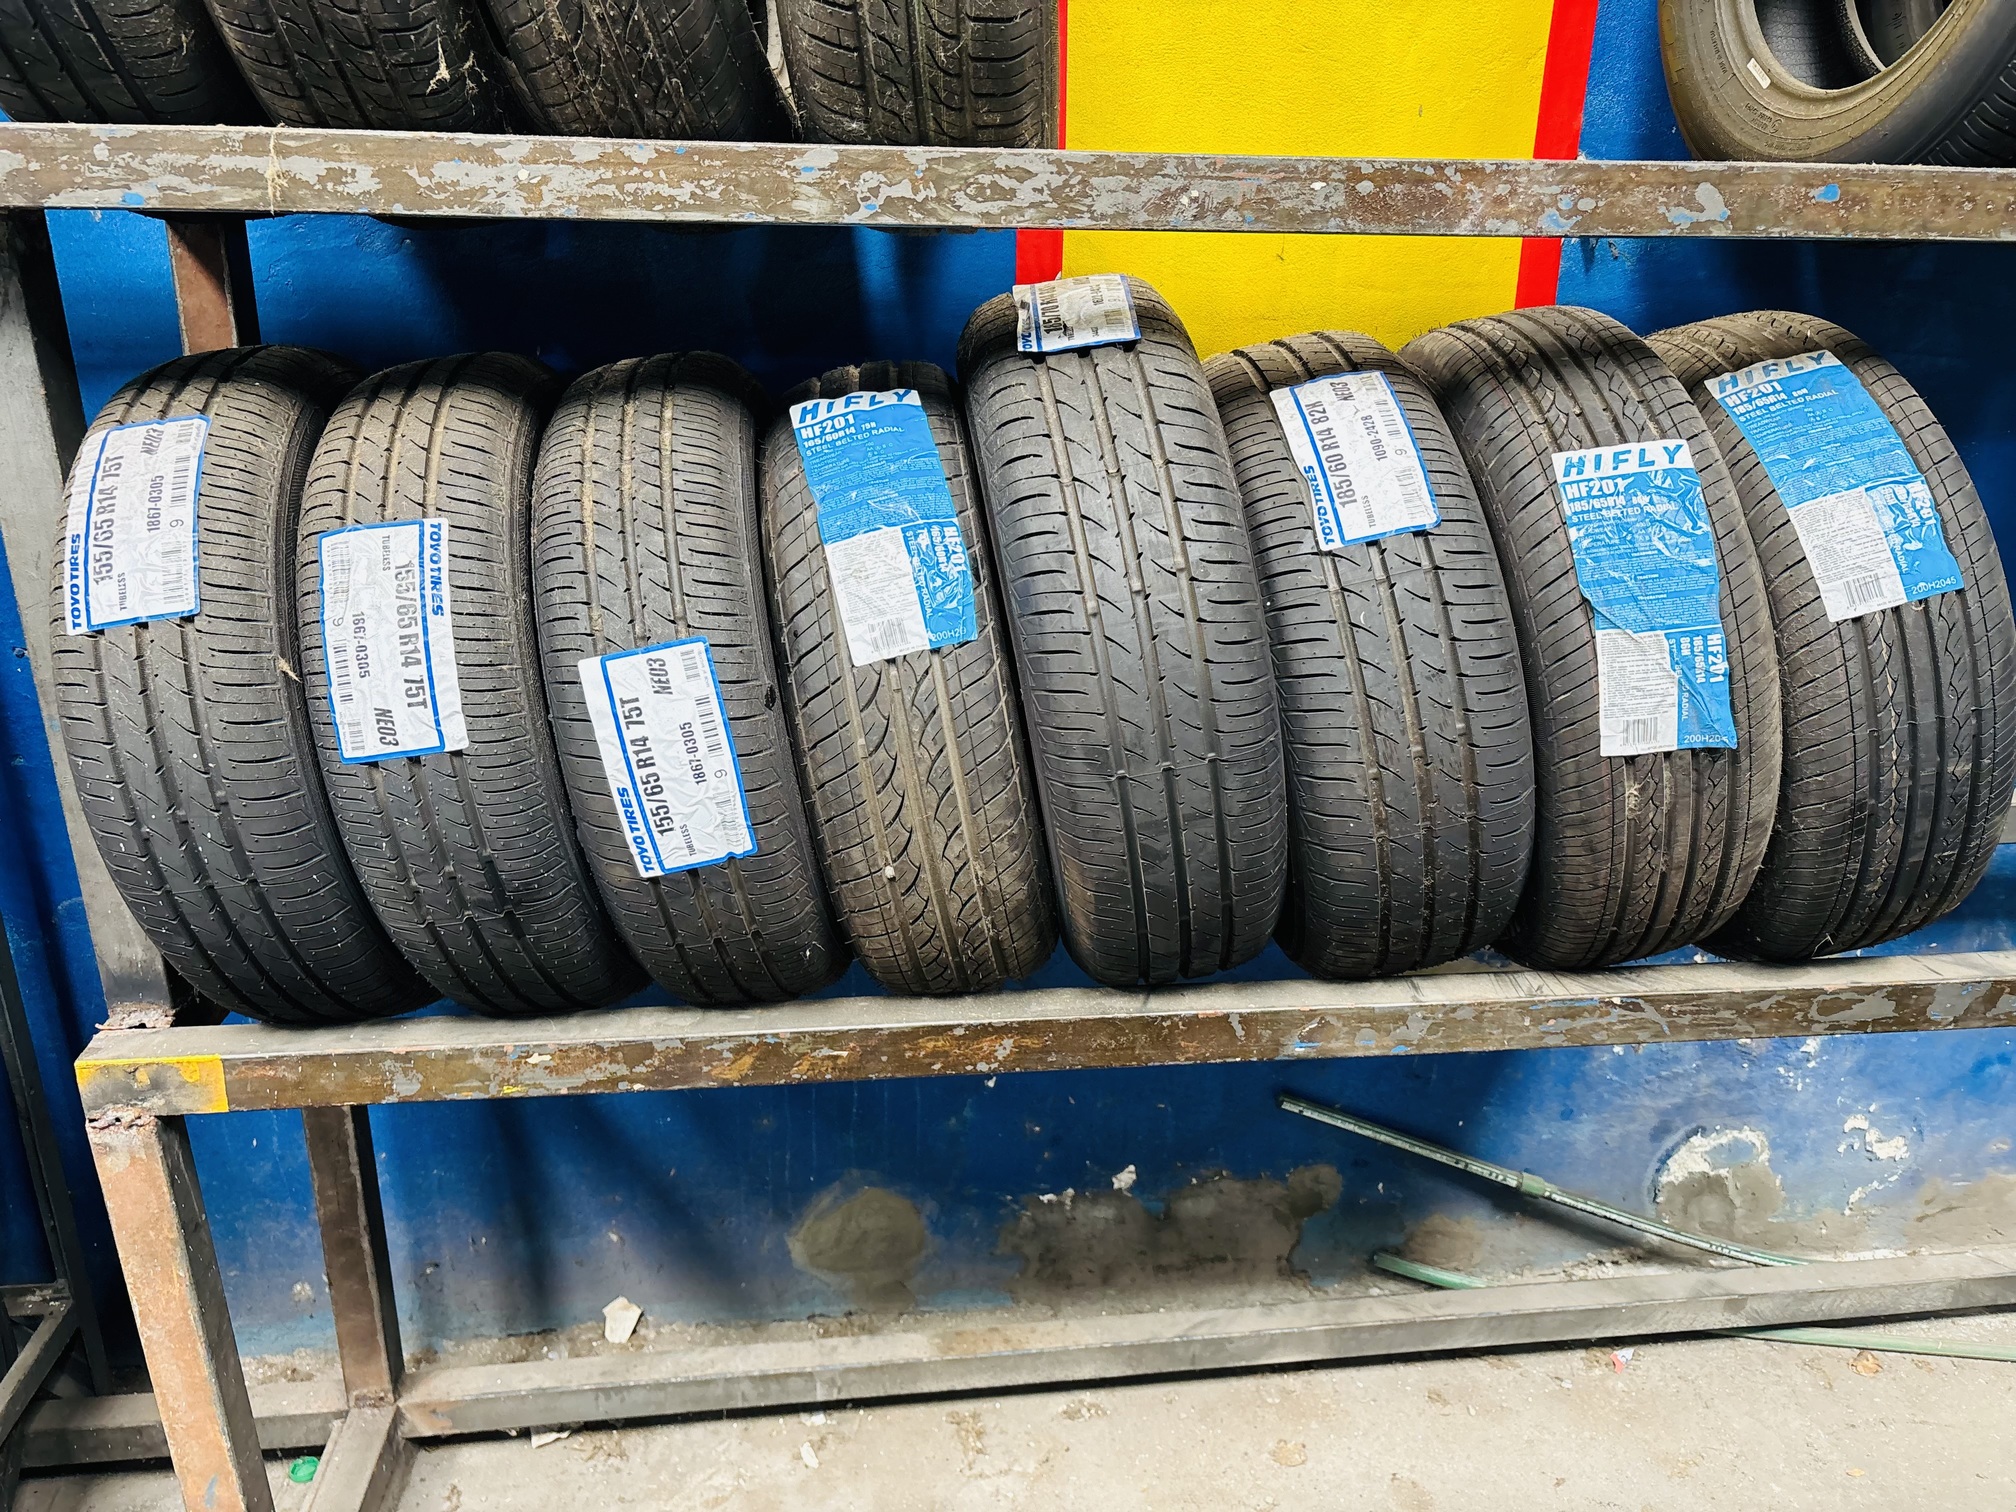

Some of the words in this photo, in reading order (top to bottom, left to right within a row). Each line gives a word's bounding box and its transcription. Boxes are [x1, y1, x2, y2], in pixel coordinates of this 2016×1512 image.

[1718, 351, 1826, 395] HIFLY
[798, 389, 912, 424] HIFLY
[1724, 381, 1783, 408] HF201
[1732, 392, 1788, 416] 185/65R14
[1738, 408, 1769, 423] STEEL
[1770, 397, 1805, 412] BELTED
[1805, 389, 1839, 402] RADIAL
[800, 413, 855, 439] HF201
[1305, 401, 1329, 425] 82H
[803, 427, 856, 448] 165/60R14
[806, 443, 834, 457] STEEL
[835, 433, 870, 446] BELTED
[871, 426, 905, 435] RADIAL
[1316, 427, 1340, 451] R14
[1361, 414, 1388, 461] 1090-2428
[101, 454, 124, 482] 75T
[1563, 444, 1684, 478] HIFLY
[1303, 465, 1323, 504] TIRES
[1325, 453, 1357, 508] 185/60
[1565, 477, 1626, 499] HF201
[147, 475, 164, 533] 1867-0305
[1361, 495, 1376, 528] TUBELESS
[1569, 495, 1626, 513] 185/65R14
[1571, 512, 1601, 523] STEEL
[1602, 507, 1641, 518] BELTED
[1644, 503, 1679, 513] RADIAL
[429, 522, 442, 563] TOYO
[1317, 505, 1335, 545] TOYO
[70, 533, 81, 580] TIRES
[93, 518, 114, 586] 155/65
[382, 535, 391, 571] TUBELESS
[1894, 546, 1909, 573] RADIAL
[429, 566, 444, 617] TIRES
[906, 531, 918, 555] STEEL
[921, 587, 933, 618] RADIAL
[1912, 576, 1957, 595] 200H2045
[70, 582, 82, 630] TOYO
[394, 560, 418, 630] 155/65
[352, 611, 371, 679] 1867-0305
[399, 633, 422, 668] R14
[1680, 636, 1691, 656] 86H
[1693, 635, 1706, 683] 185/65R14
[1707, 633, 1725, 683] HF201
[404, 675, 428, 709] 75T
[1681, 692, 1690, 721] RADIAL
[619, 697, 645, 730] 75T
[630, 735, 656, 770] R14
[680, 722, 708, 785] 1867-0305
[616, 787, 640, 834] TIRES
[641, 772, 675, 836] 155/65
[632, 836, 655, 873] TOYO
[680, 824, 697, 856] TUBELESS
